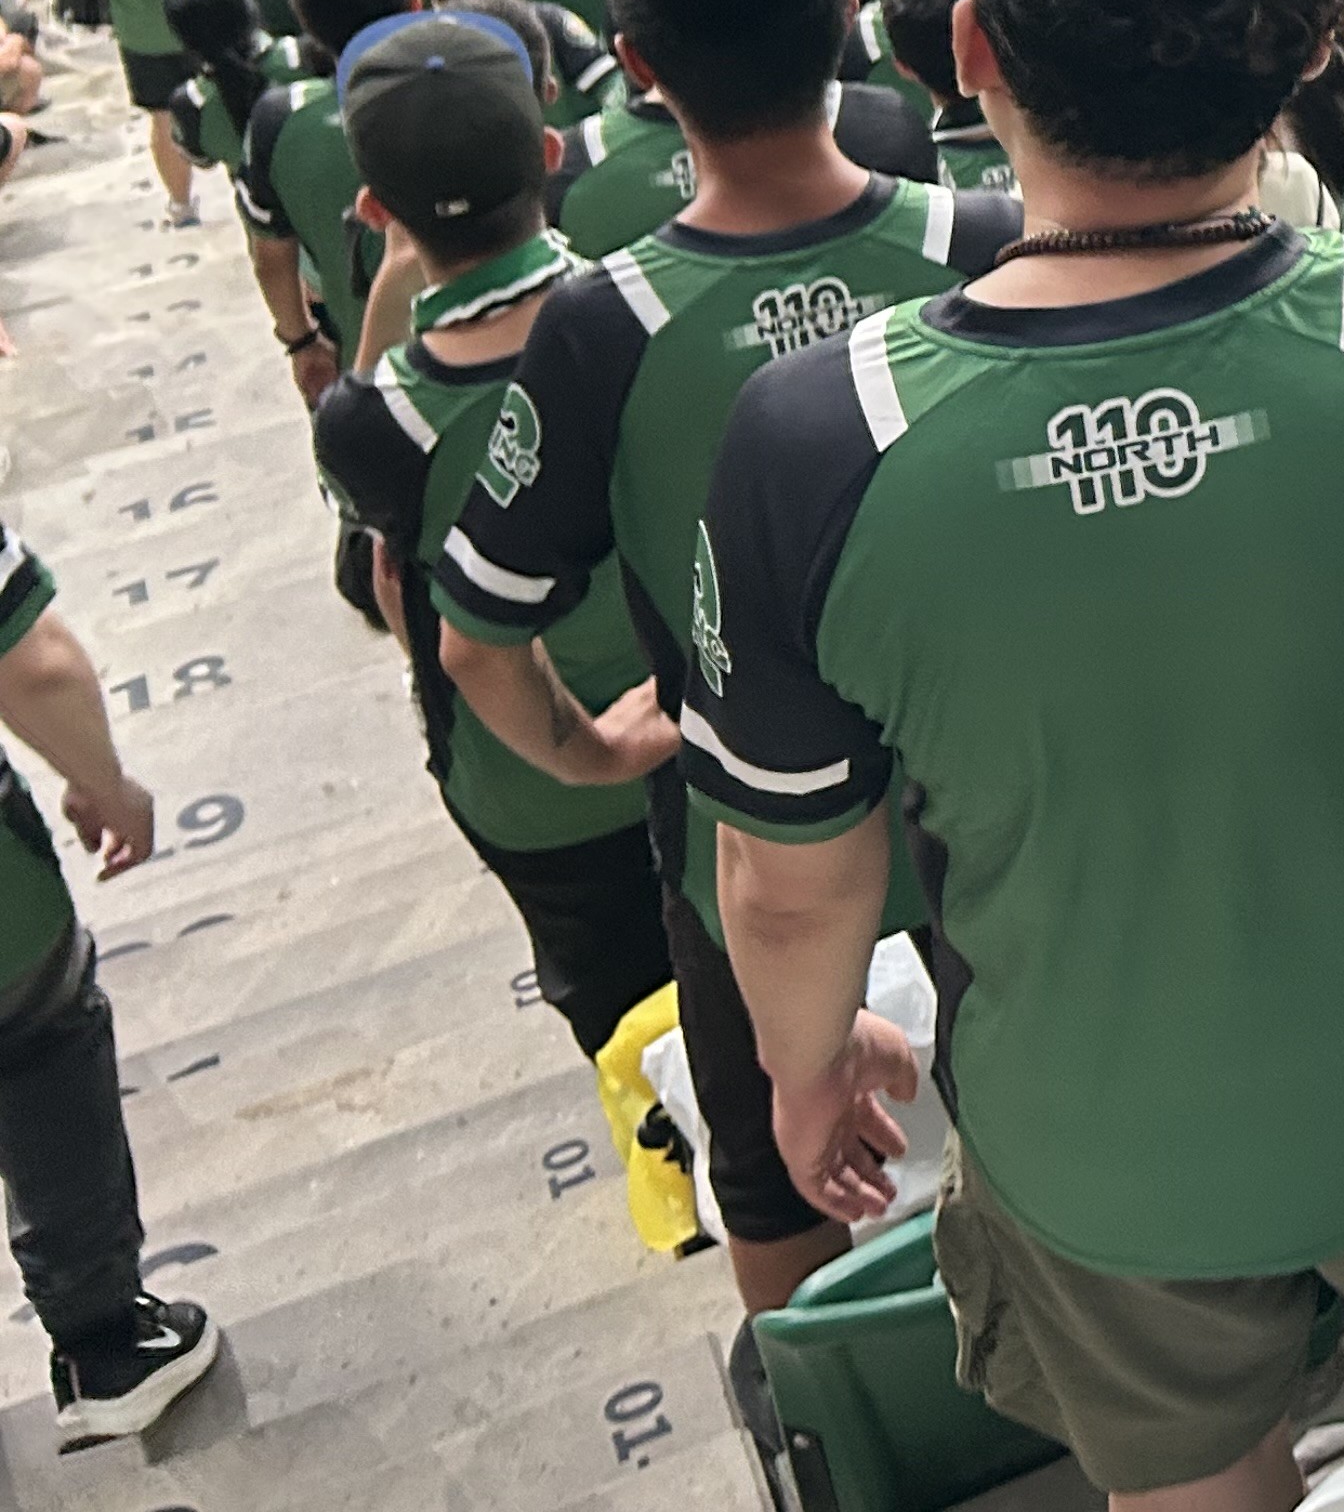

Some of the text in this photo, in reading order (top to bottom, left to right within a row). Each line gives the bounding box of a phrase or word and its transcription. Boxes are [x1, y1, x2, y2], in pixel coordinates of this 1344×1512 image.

[753, 276, 852, 359] 110
[1048, 387, 1207, 515] 110
[1051, 425, 1220, 478] NORTH
[112, 555, 220, 606] 17
[109, 654, 232, 713] 18
[542, 1138, 597, 1200] 10
